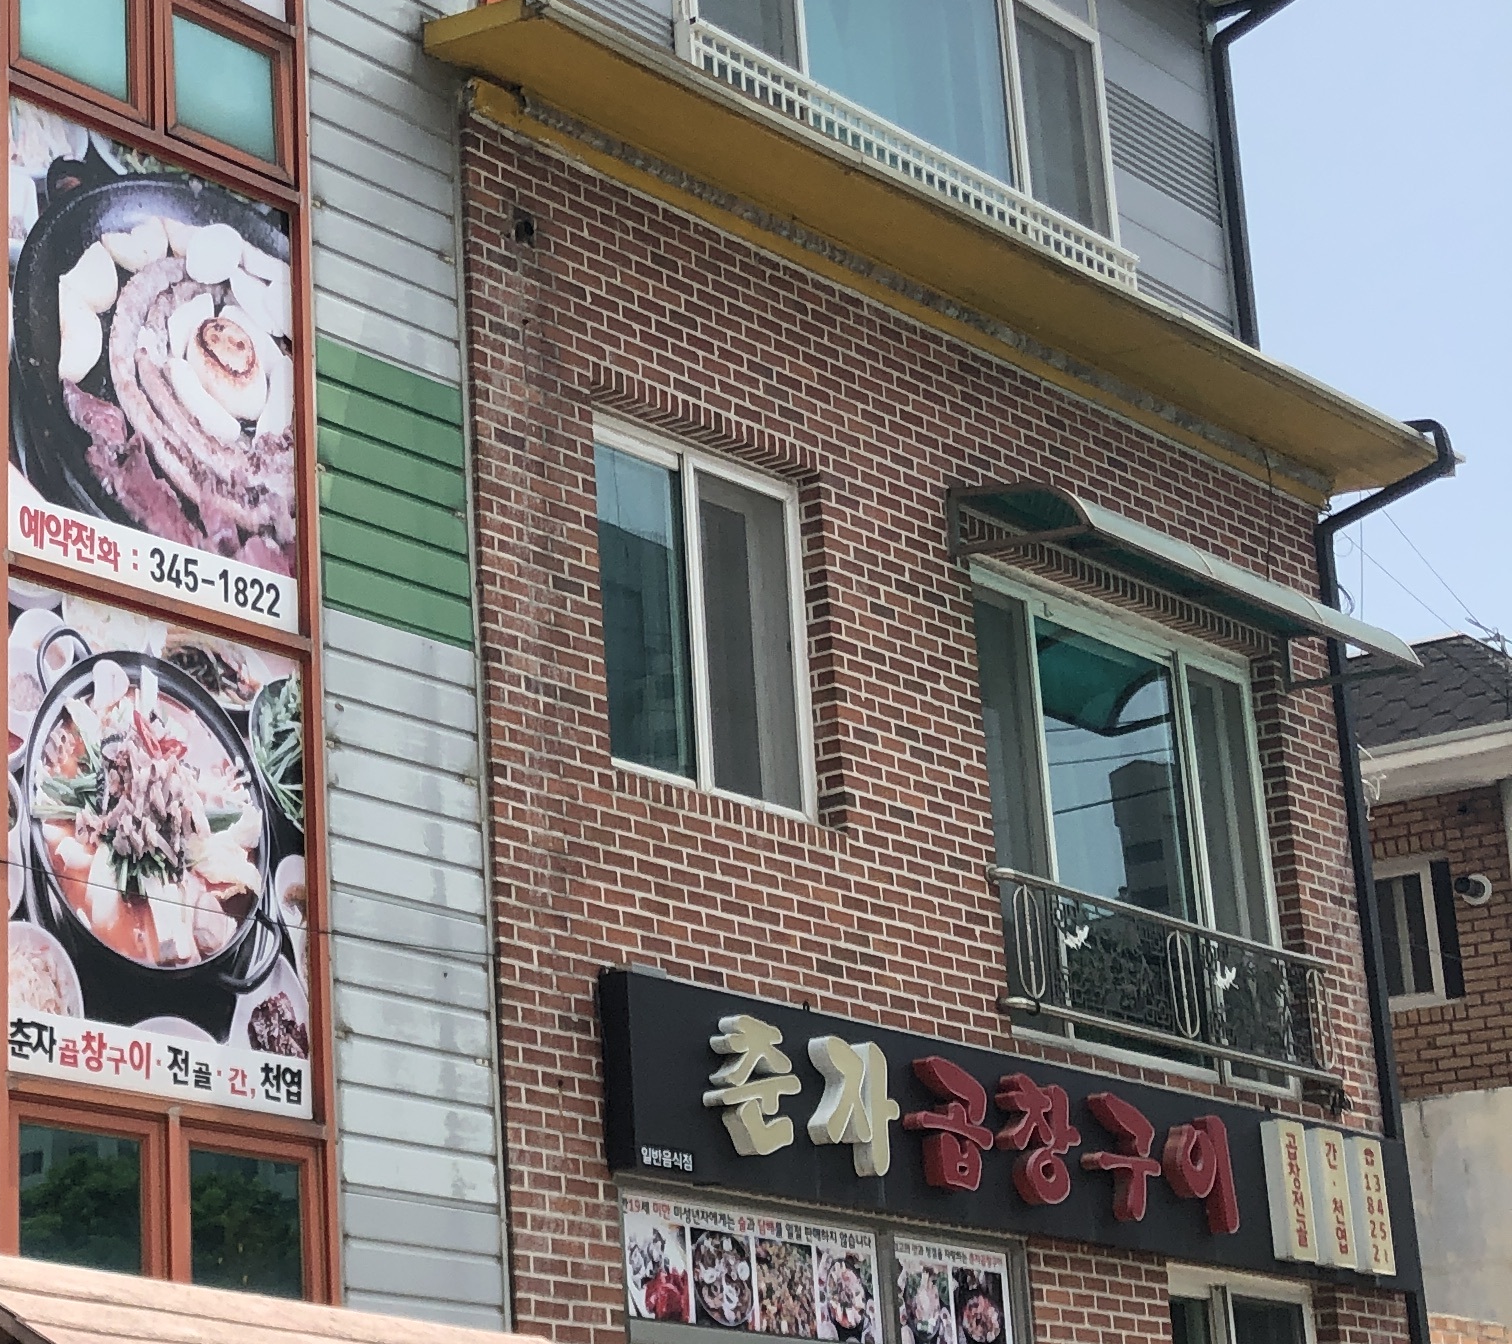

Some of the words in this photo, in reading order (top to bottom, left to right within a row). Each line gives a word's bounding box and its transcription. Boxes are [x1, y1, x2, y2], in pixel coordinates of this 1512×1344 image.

[19, 506, 121, 572] 예약전화
[149, 547, 281, 618] 345-1822
[260, 1063, 303, 1105] 천엽
[641, 1146, 693, 1171] 일반음식점
[1285, 1132, 1309, 1249] 곱창전골
